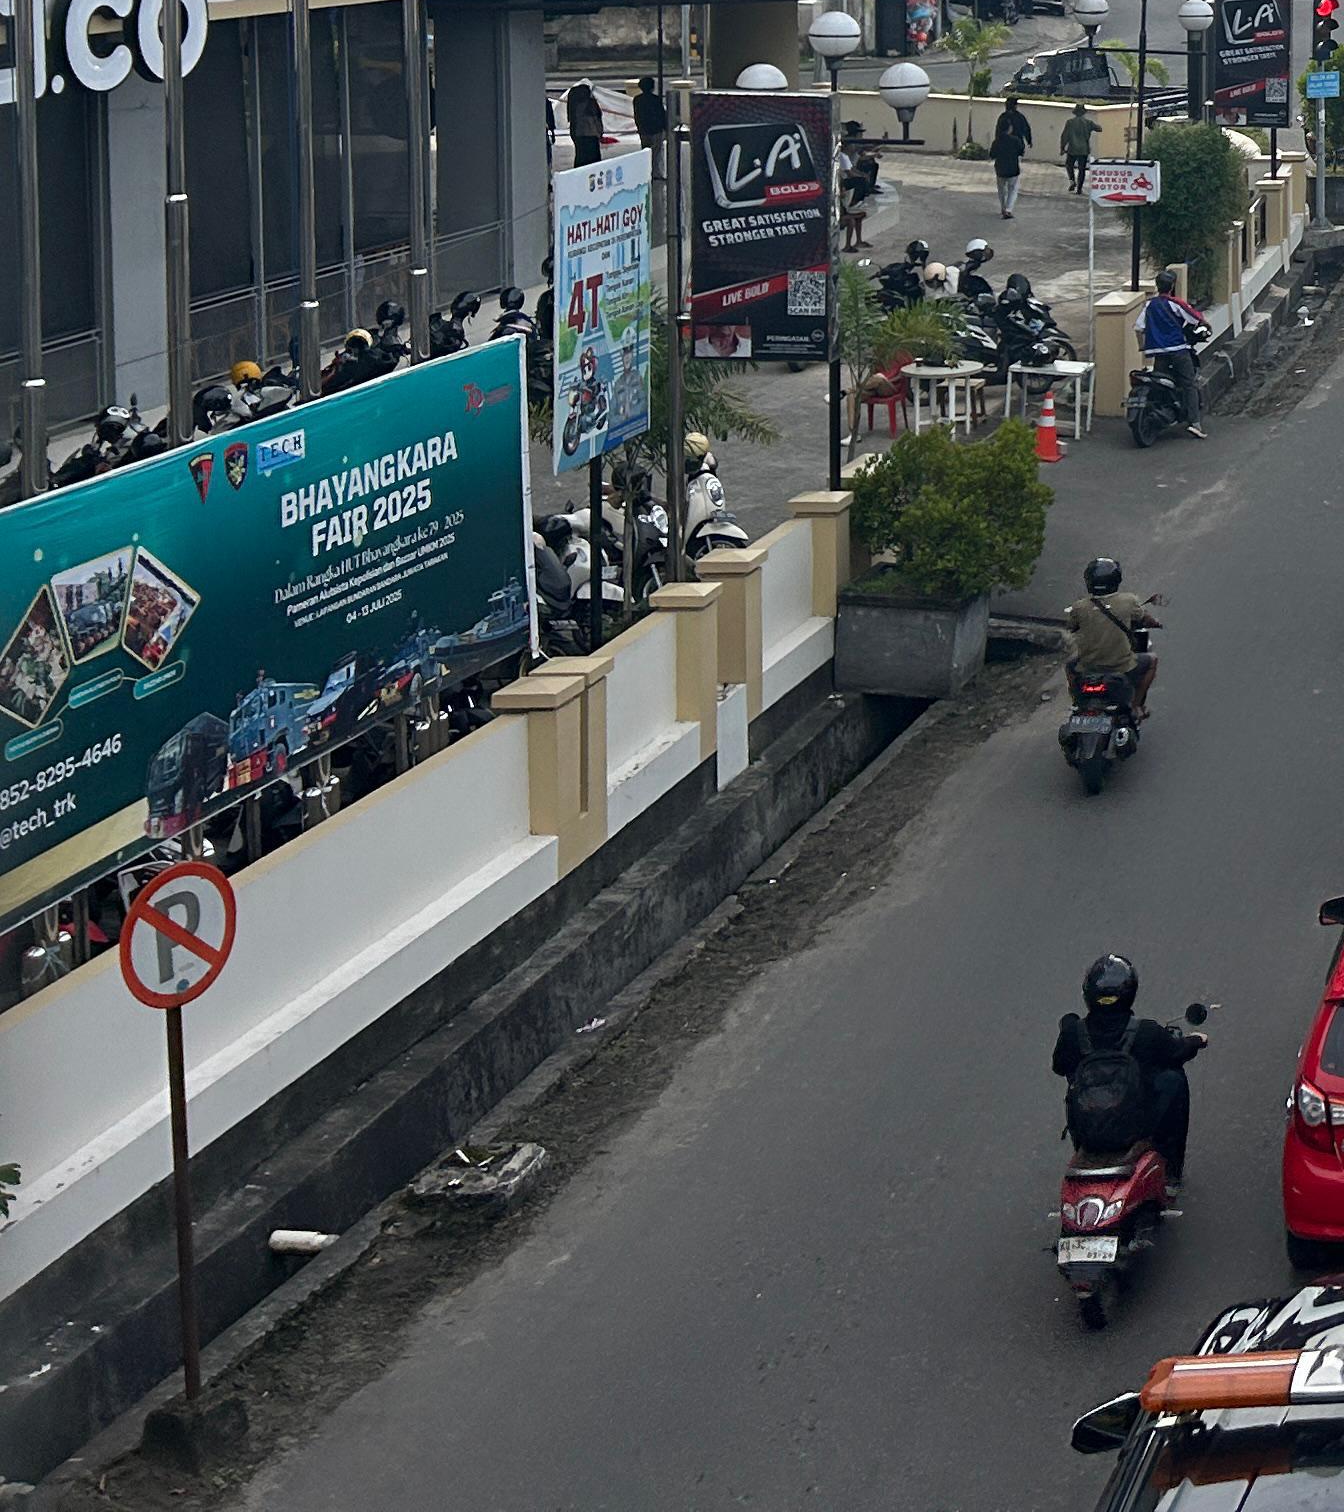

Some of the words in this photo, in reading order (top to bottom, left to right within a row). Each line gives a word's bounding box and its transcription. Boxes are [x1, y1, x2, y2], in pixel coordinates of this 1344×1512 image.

[769, 183, 810, 196] BOLD
[567, 211, 620, 246] HATI-HATI
[622, 203, 645, 227] GOY
[702, 215, 747, 234] GREAT
[749, 208, 822, 230] SATISFACTION
[708, 226, 777, 248] STRONGER
[776, 222, 808, 238] TASTE
[567, 273, 604, 335] 4T
[722, 291, 743, 307] LIVE
[744, 281, 770, 301] BOLD
[280, 431, 459, 529] BHAYANGKARA
[311, 504, 369, 558] FAIR
[372, 478, 432, 533] 2025
[274, 581, 307, 604] Dalam
[306, 561, 341, 588] Rangka
[0, 792, 77, 850] @tech_trk
